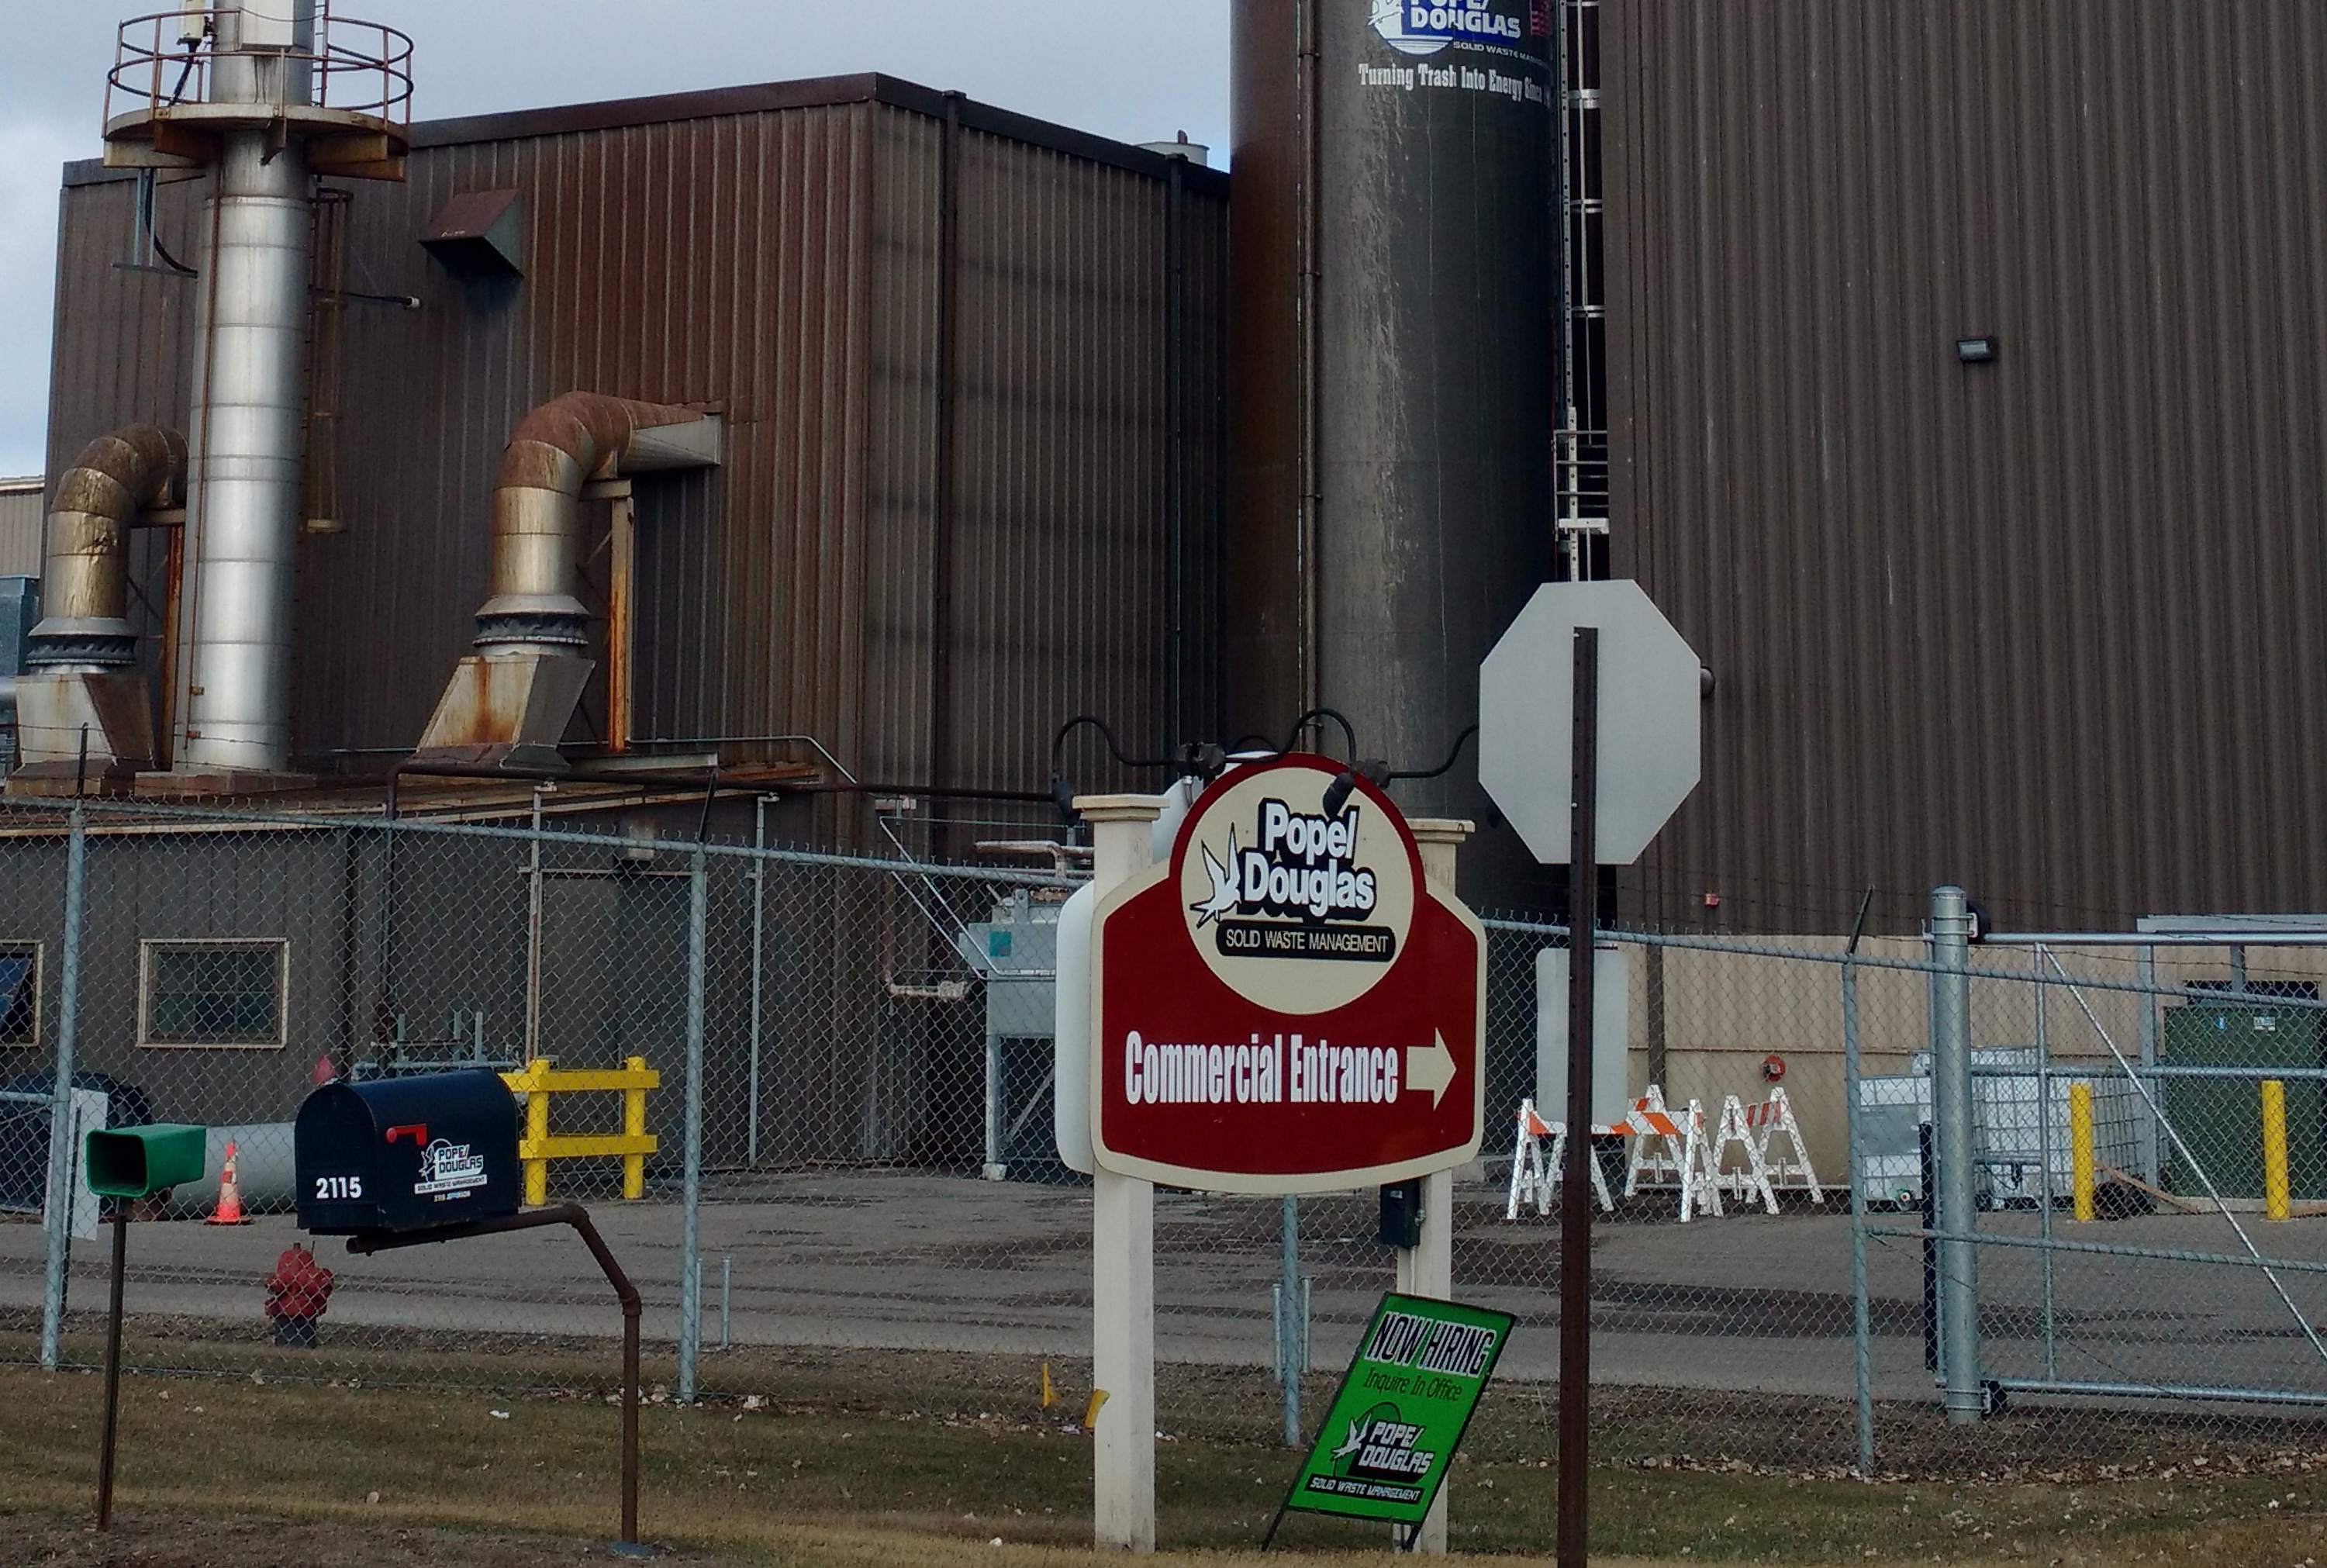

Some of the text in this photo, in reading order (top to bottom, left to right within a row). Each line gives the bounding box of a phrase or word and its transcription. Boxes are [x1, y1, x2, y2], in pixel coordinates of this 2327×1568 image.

[1410, 6, 1521, 39] DOUGLAS
[1452, 41, 1518, 58] SOLID WASTE
[1358, 62, 1414, 91] Turning
[1417, 63, 1457, 88] Trash
[1461, 65, 1485, 91] Into
[1488, 68, 1522, 102] Energy
[1244, 851, 1375, 917] Douglas
[1225, 928, 1389, 953] SOLID WASTE MANAGEMENT
[1124, 1030, 1399, 1105] Commercial Entrance
[439, 1157, 483, 1173] DOUGLAS
[316, 1176, 362, 1199] 2115
[1363, 1310, 1498, 1379] NOW HIRING
[1362, 1366, 1463, 1401] Inquire In Office
[1358, 1445, 1435, 1473] DOUGLAS
[1310, 1476, 1421, 1501] SOLID WASTE MANAGEMENT
